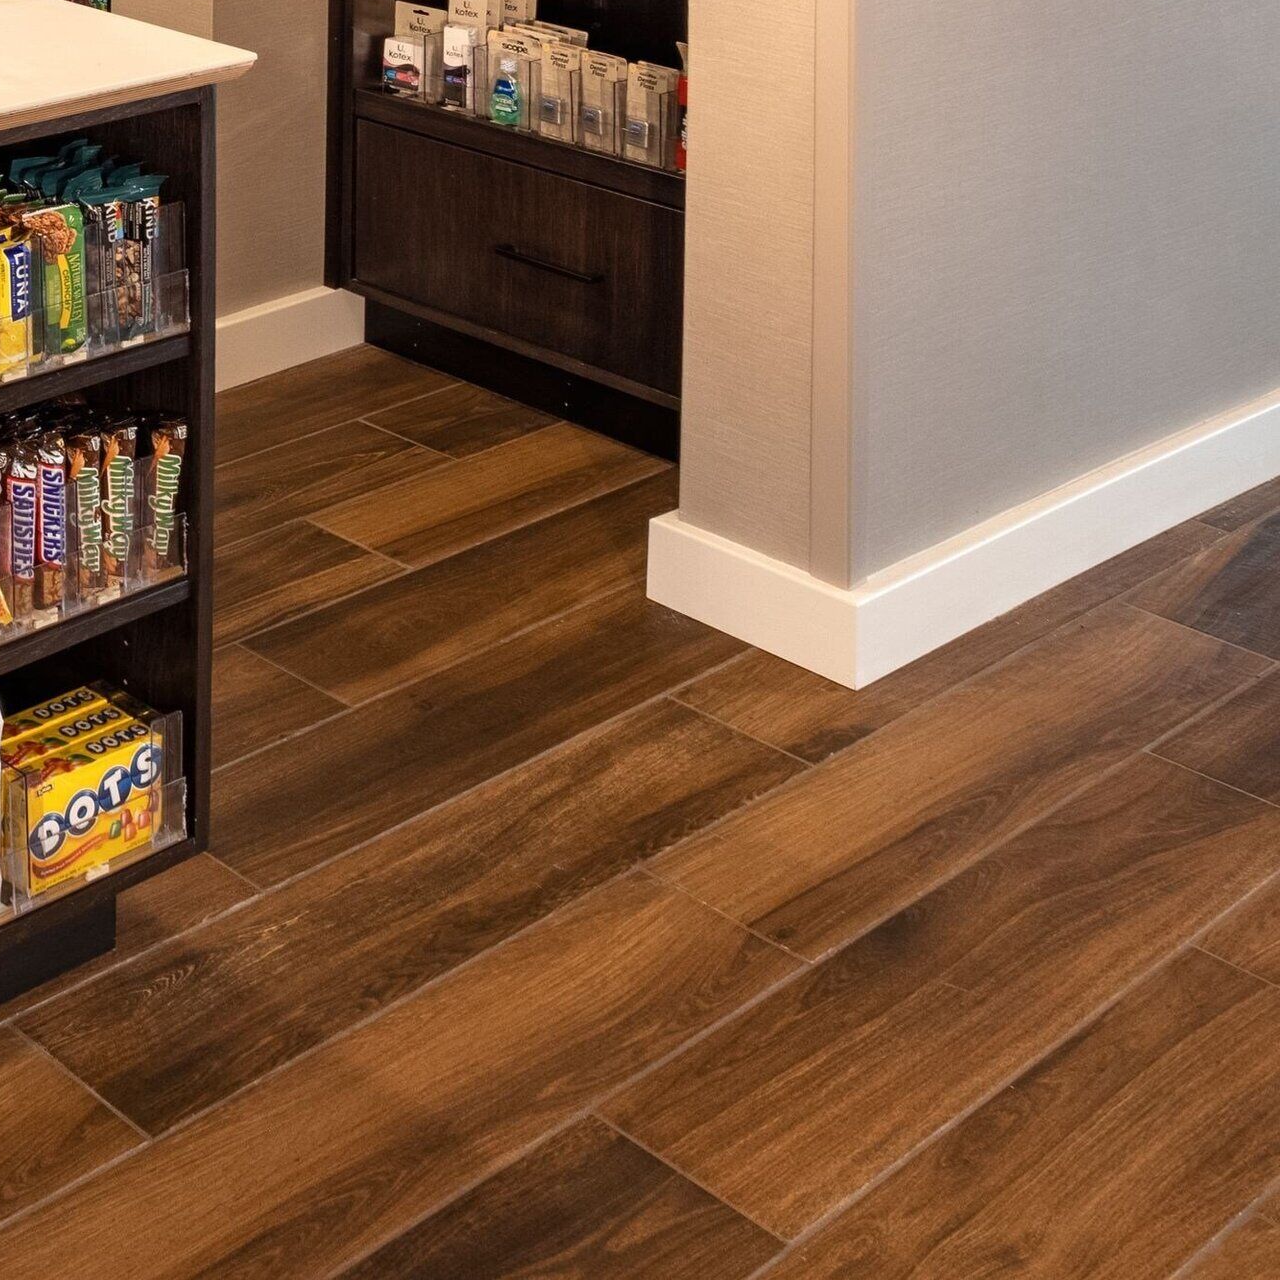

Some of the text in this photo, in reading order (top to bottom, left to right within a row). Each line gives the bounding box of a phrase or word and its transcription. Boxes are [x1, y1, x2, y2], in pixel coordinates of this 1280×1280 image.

[455, 7, 478, 18] kotex
[389, 50, 413, 62] kotex
[501, 41, 528, 54] scope
[550, 55, 569, 63] Dental
[589, 64, 608, 72] Dental
[637, 76, 658, 85] Dental
[104, 202, 118, 243] KIND
[143, 198, 155, 239] KIND
[13, 252, 29, 313] LUNA
[62, 269, 71, 311] CRUNCHY
[42, 471, 65, 564] SNICKERS
[35, 686, 96, 719] DOTS
[60, 706, 121, 738] DOTS
[86, 723, 149, 755] DOTS
[29, 744, 162, 860] DOTS
